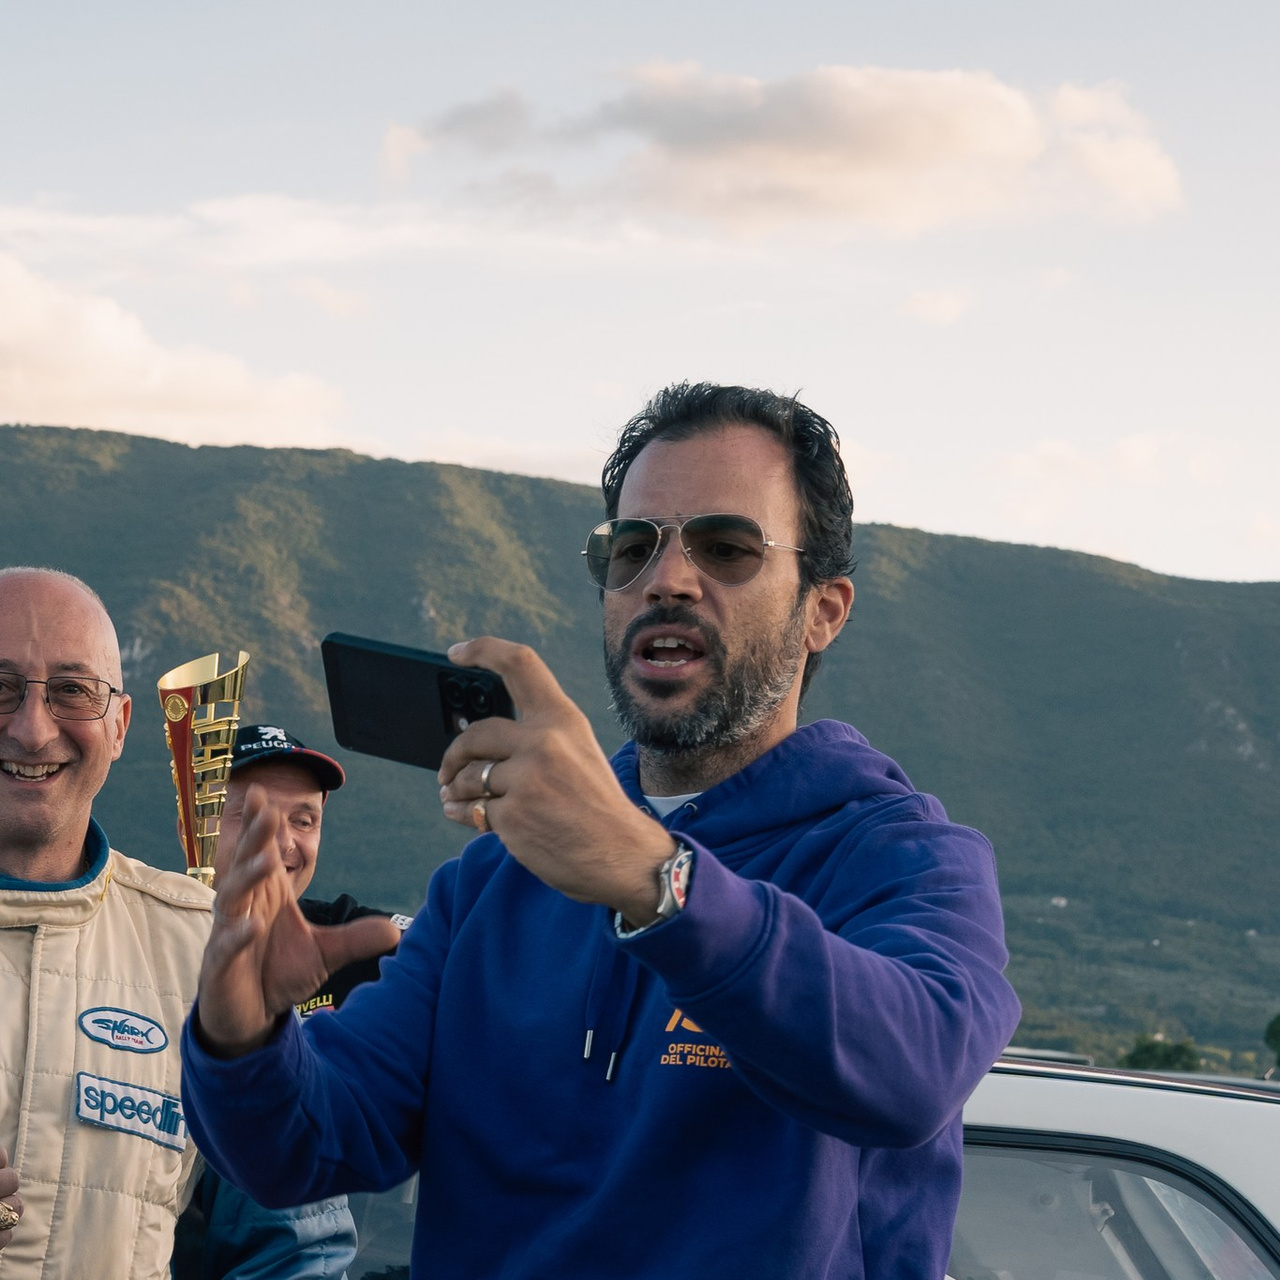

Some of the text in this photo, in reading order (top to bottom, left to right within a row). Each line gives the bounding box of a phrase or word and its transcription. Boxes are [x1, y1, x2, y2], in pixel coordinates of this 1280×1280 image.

[240, 741, 296, 750] PEUGE
[92, 1018, 155, 1044] SHARK
[660, 1054, 683, 1065] DEL
[84, 1086, 189, 1139] speedlin
